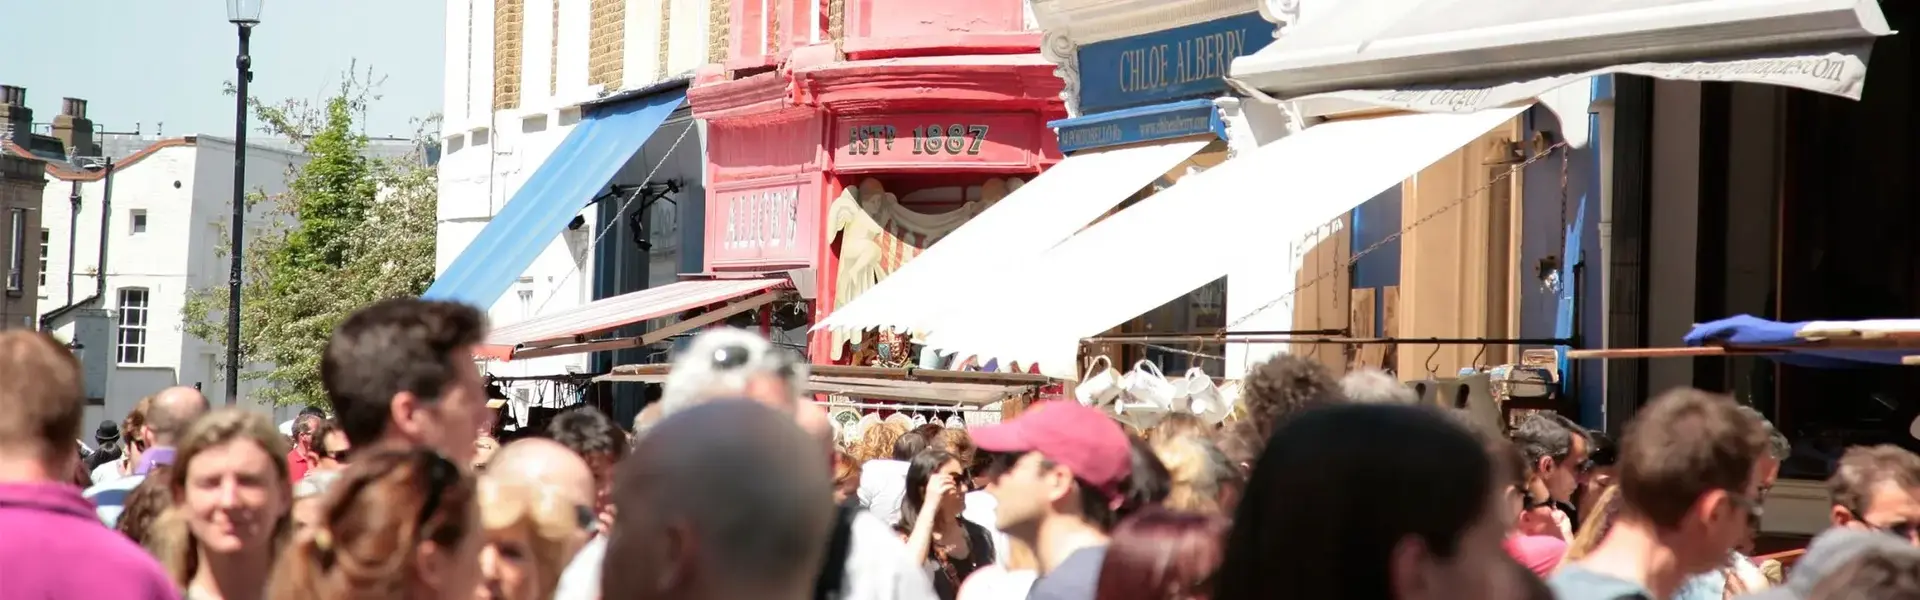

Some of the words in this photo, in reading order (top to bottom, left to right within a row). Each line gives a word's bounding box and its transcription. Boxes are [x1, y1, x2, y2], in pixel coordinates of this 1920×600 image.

[1119, 44, 1169, 92] CHLOE
[1174, 28, 1247, 84] ALBERRY
[912, 123, 990, 155] 1887
